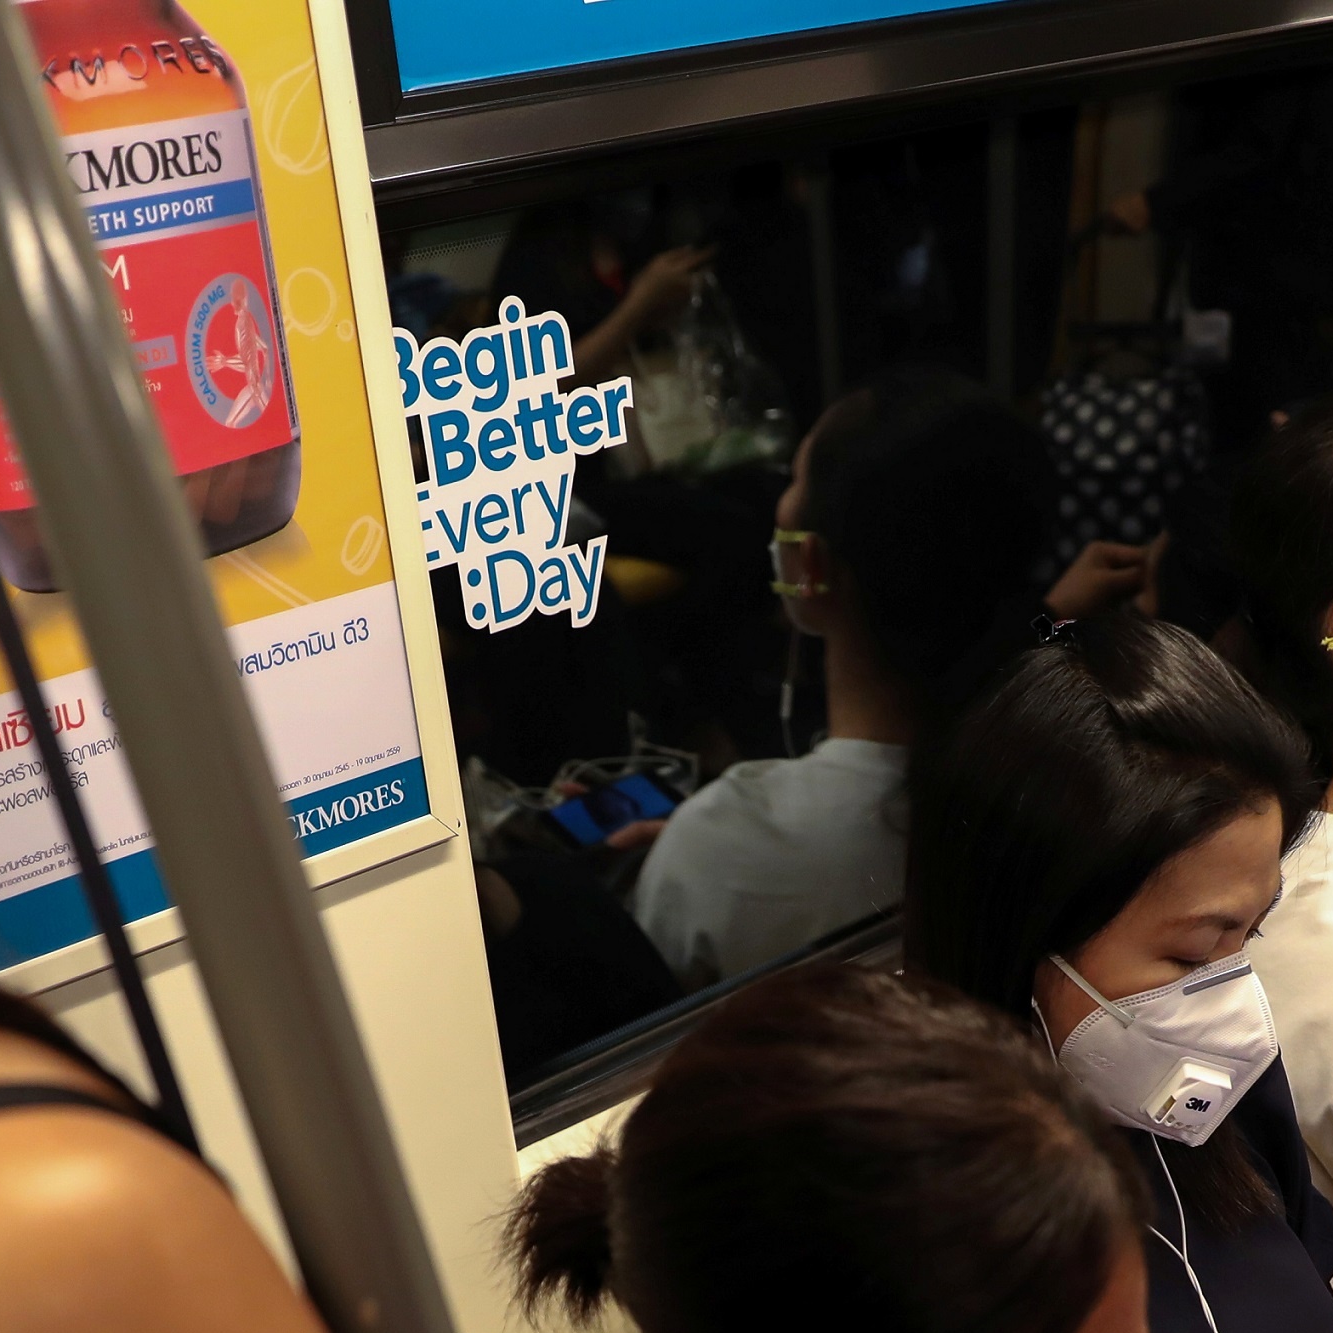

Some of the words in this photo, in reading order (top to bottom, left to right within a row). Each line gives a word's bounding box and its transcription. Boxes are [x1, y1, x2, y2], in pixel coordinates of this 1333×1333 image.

[133, 195, 214, 227] SUPPORT
[207, 284, 226, 305] MG
[193, 301, 209, 331] 500
[190, 333, 217, 406] CALCIUM
[393, 304, 568, 413] Begin
[427, 383, 628, 488] Better
[303, 775, 312, 785] 30
[1185, 1097, 1211, 1112] 3M
